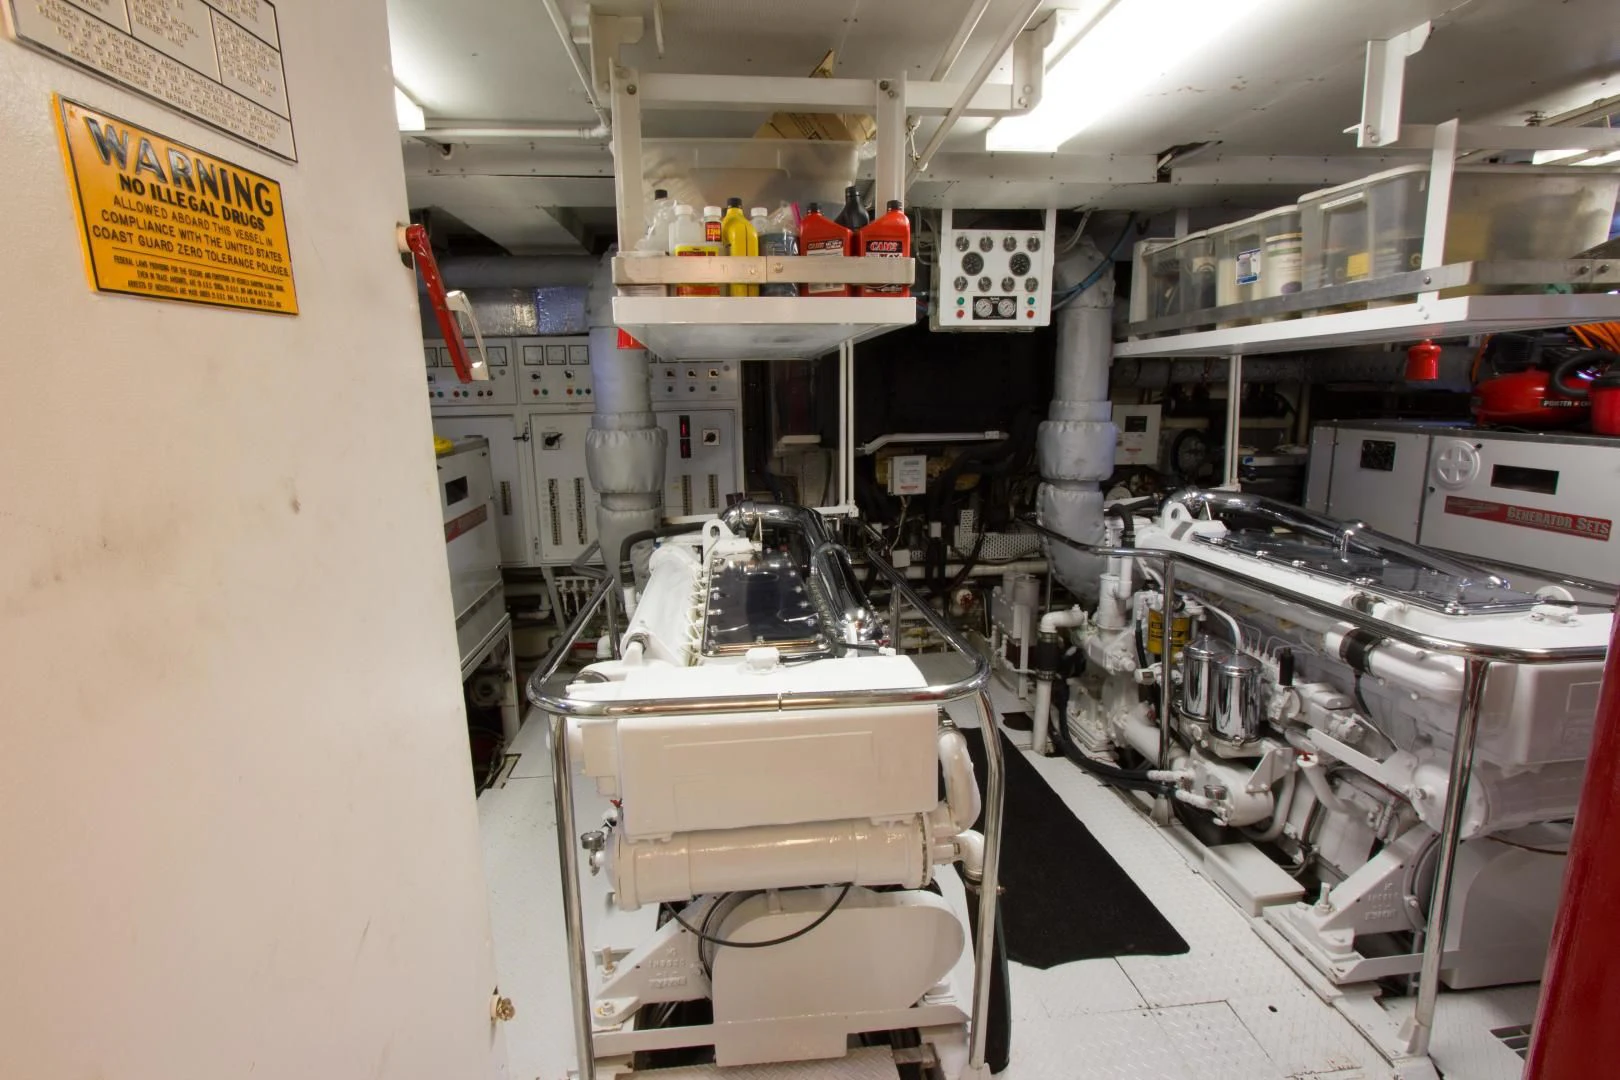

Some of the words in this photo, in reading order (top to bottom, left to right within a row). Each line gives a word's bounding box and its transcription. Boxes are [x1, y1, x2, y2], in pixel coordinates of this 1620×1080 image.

[83, 115, 274, 217] WARNING
[113, 195, 168, 219] ALLOWED
[171, 211, 210, 230] ABOARD
[212, 222, 231, 236] THIS
[235, 229, 263, 244] VESSEL
[266, 238, 272, 246] IN
[120, 174, 146, 197] NO
[151, 183, 219, 218] ILLEGAL
[222, 206, 265, 231] DRUGS
[92, 225, 135, 244] COAST
[138, 235, 174, 252] GUARD
[177, 244, 203, 258] ZERO
[206, 250, 254, 269] TOLERANCE
[101, 209, 175, 237] COMPLIANCE
[179, 228, 202, 243] WITH
[205, 235, 222, 248] THE
[225, 240, 254, 255] UNITED
[256, 248, 282, 262] STATES
[113, 255, 133, 265] FEDERAL
[1507, 506, 1572, 529] GENERATOR
[1576, 517, 1609, 534] SETS
